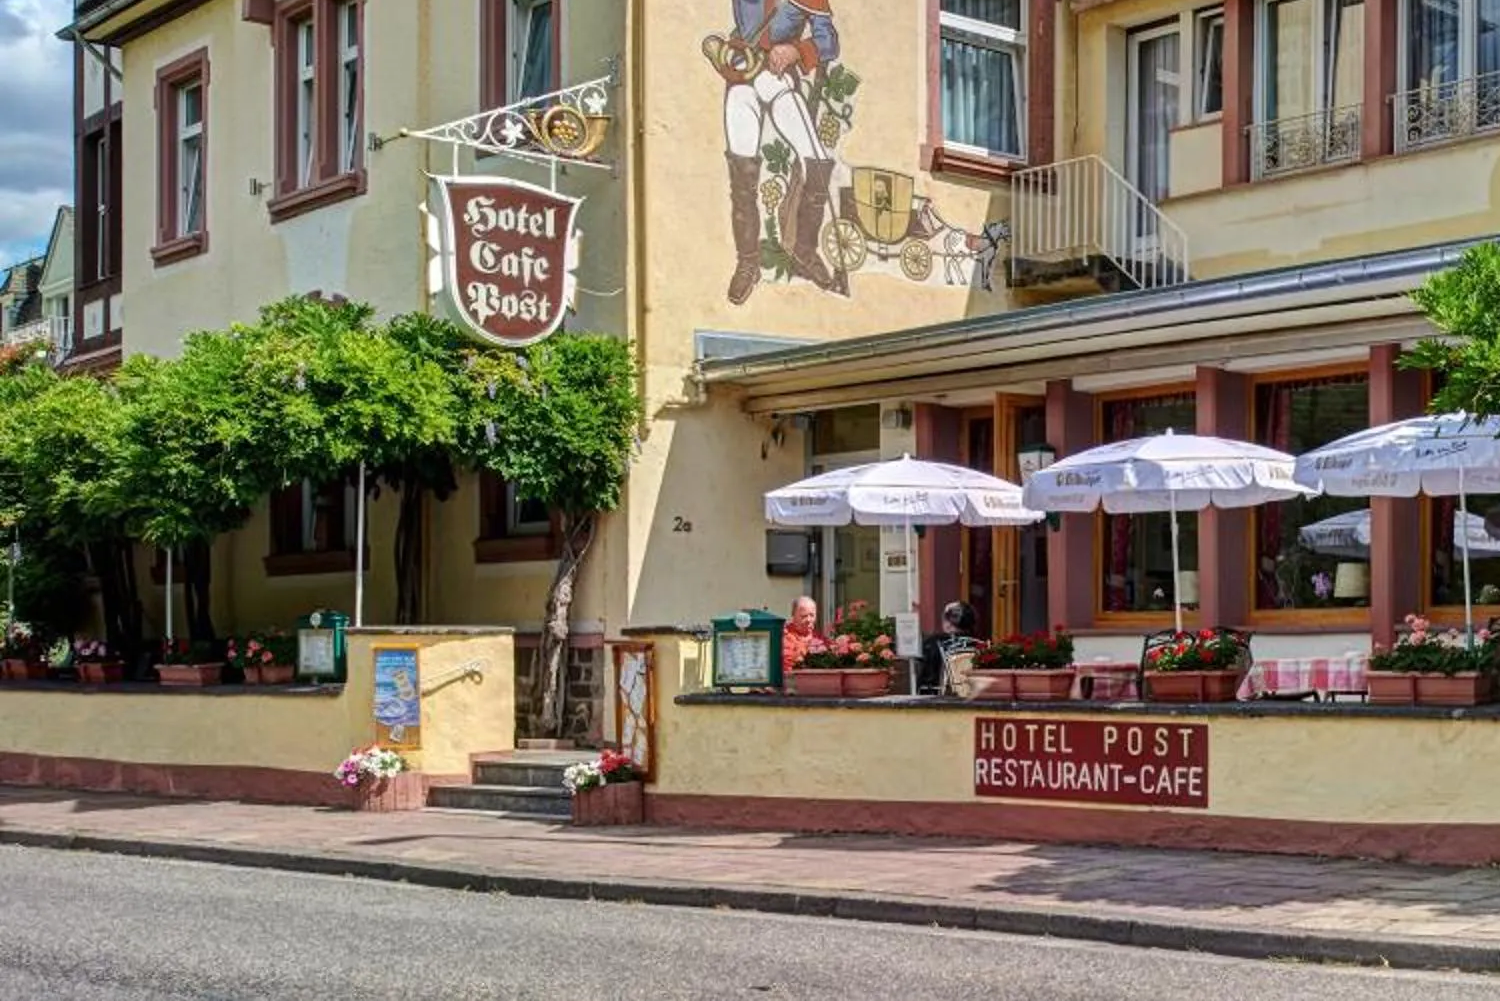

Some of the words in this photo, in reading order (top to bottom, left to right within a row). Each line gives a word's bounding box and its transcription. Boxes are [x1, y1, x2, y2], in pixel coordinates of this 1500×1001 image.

[463, 195, 556, 239] Hotel
[469, 240, 550, 287] Cafe
[467, 281, 552, 326] Post
[981, 722, 1073, 753] HOTEL
[1103, 726, 1193, 758] POST
[975, 758, 1203, 796] RESTAURANT-CAFE
